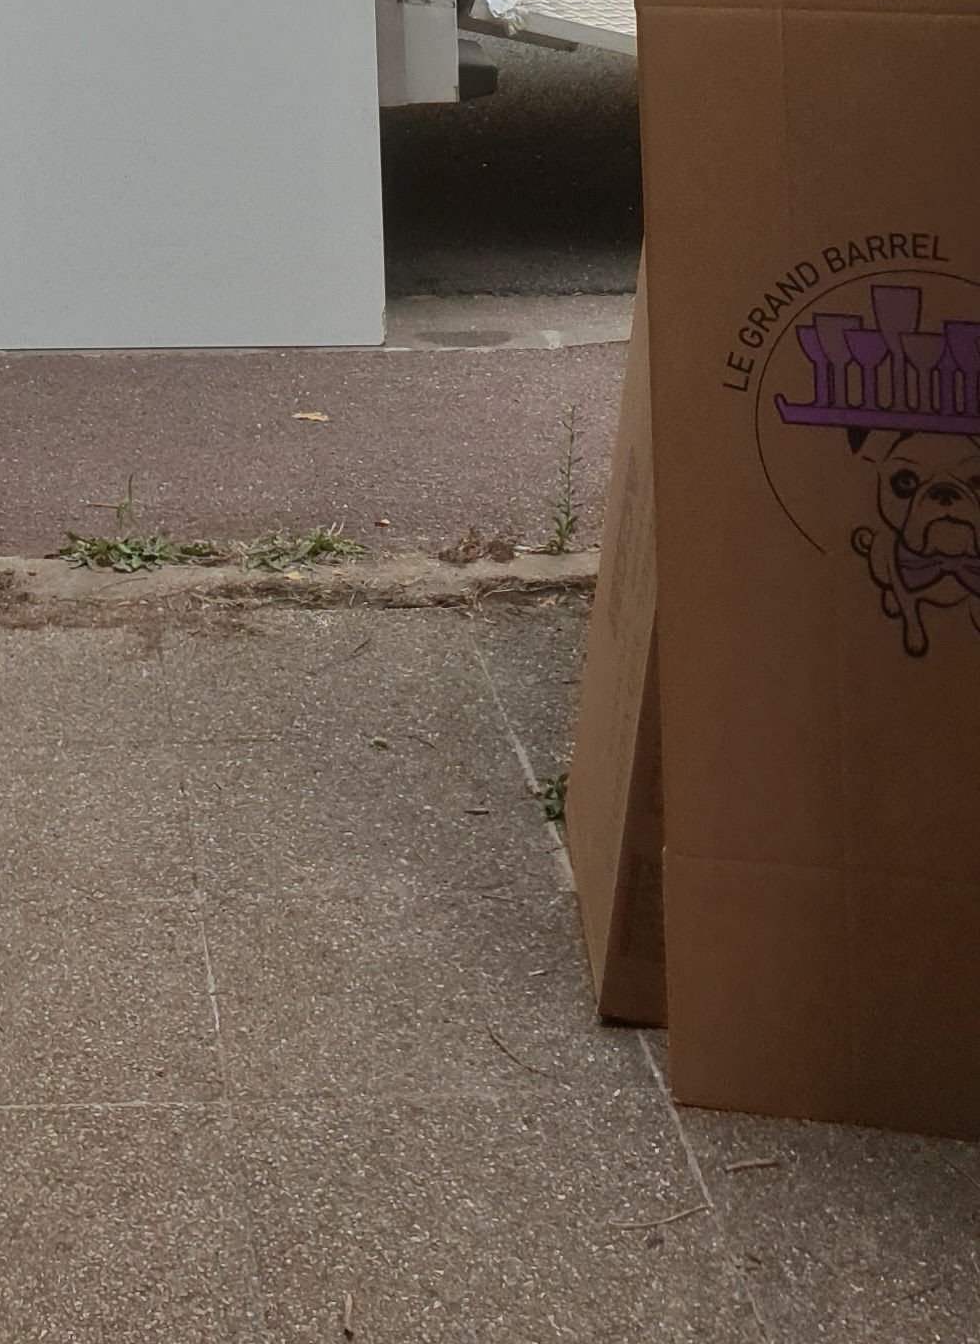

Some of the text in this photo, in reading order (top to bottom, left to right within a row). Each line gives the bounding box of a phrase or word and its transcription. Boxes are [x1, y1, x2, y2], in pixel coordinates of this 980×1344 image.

[722, 232, 950, 394] LE GRAND BARREL
